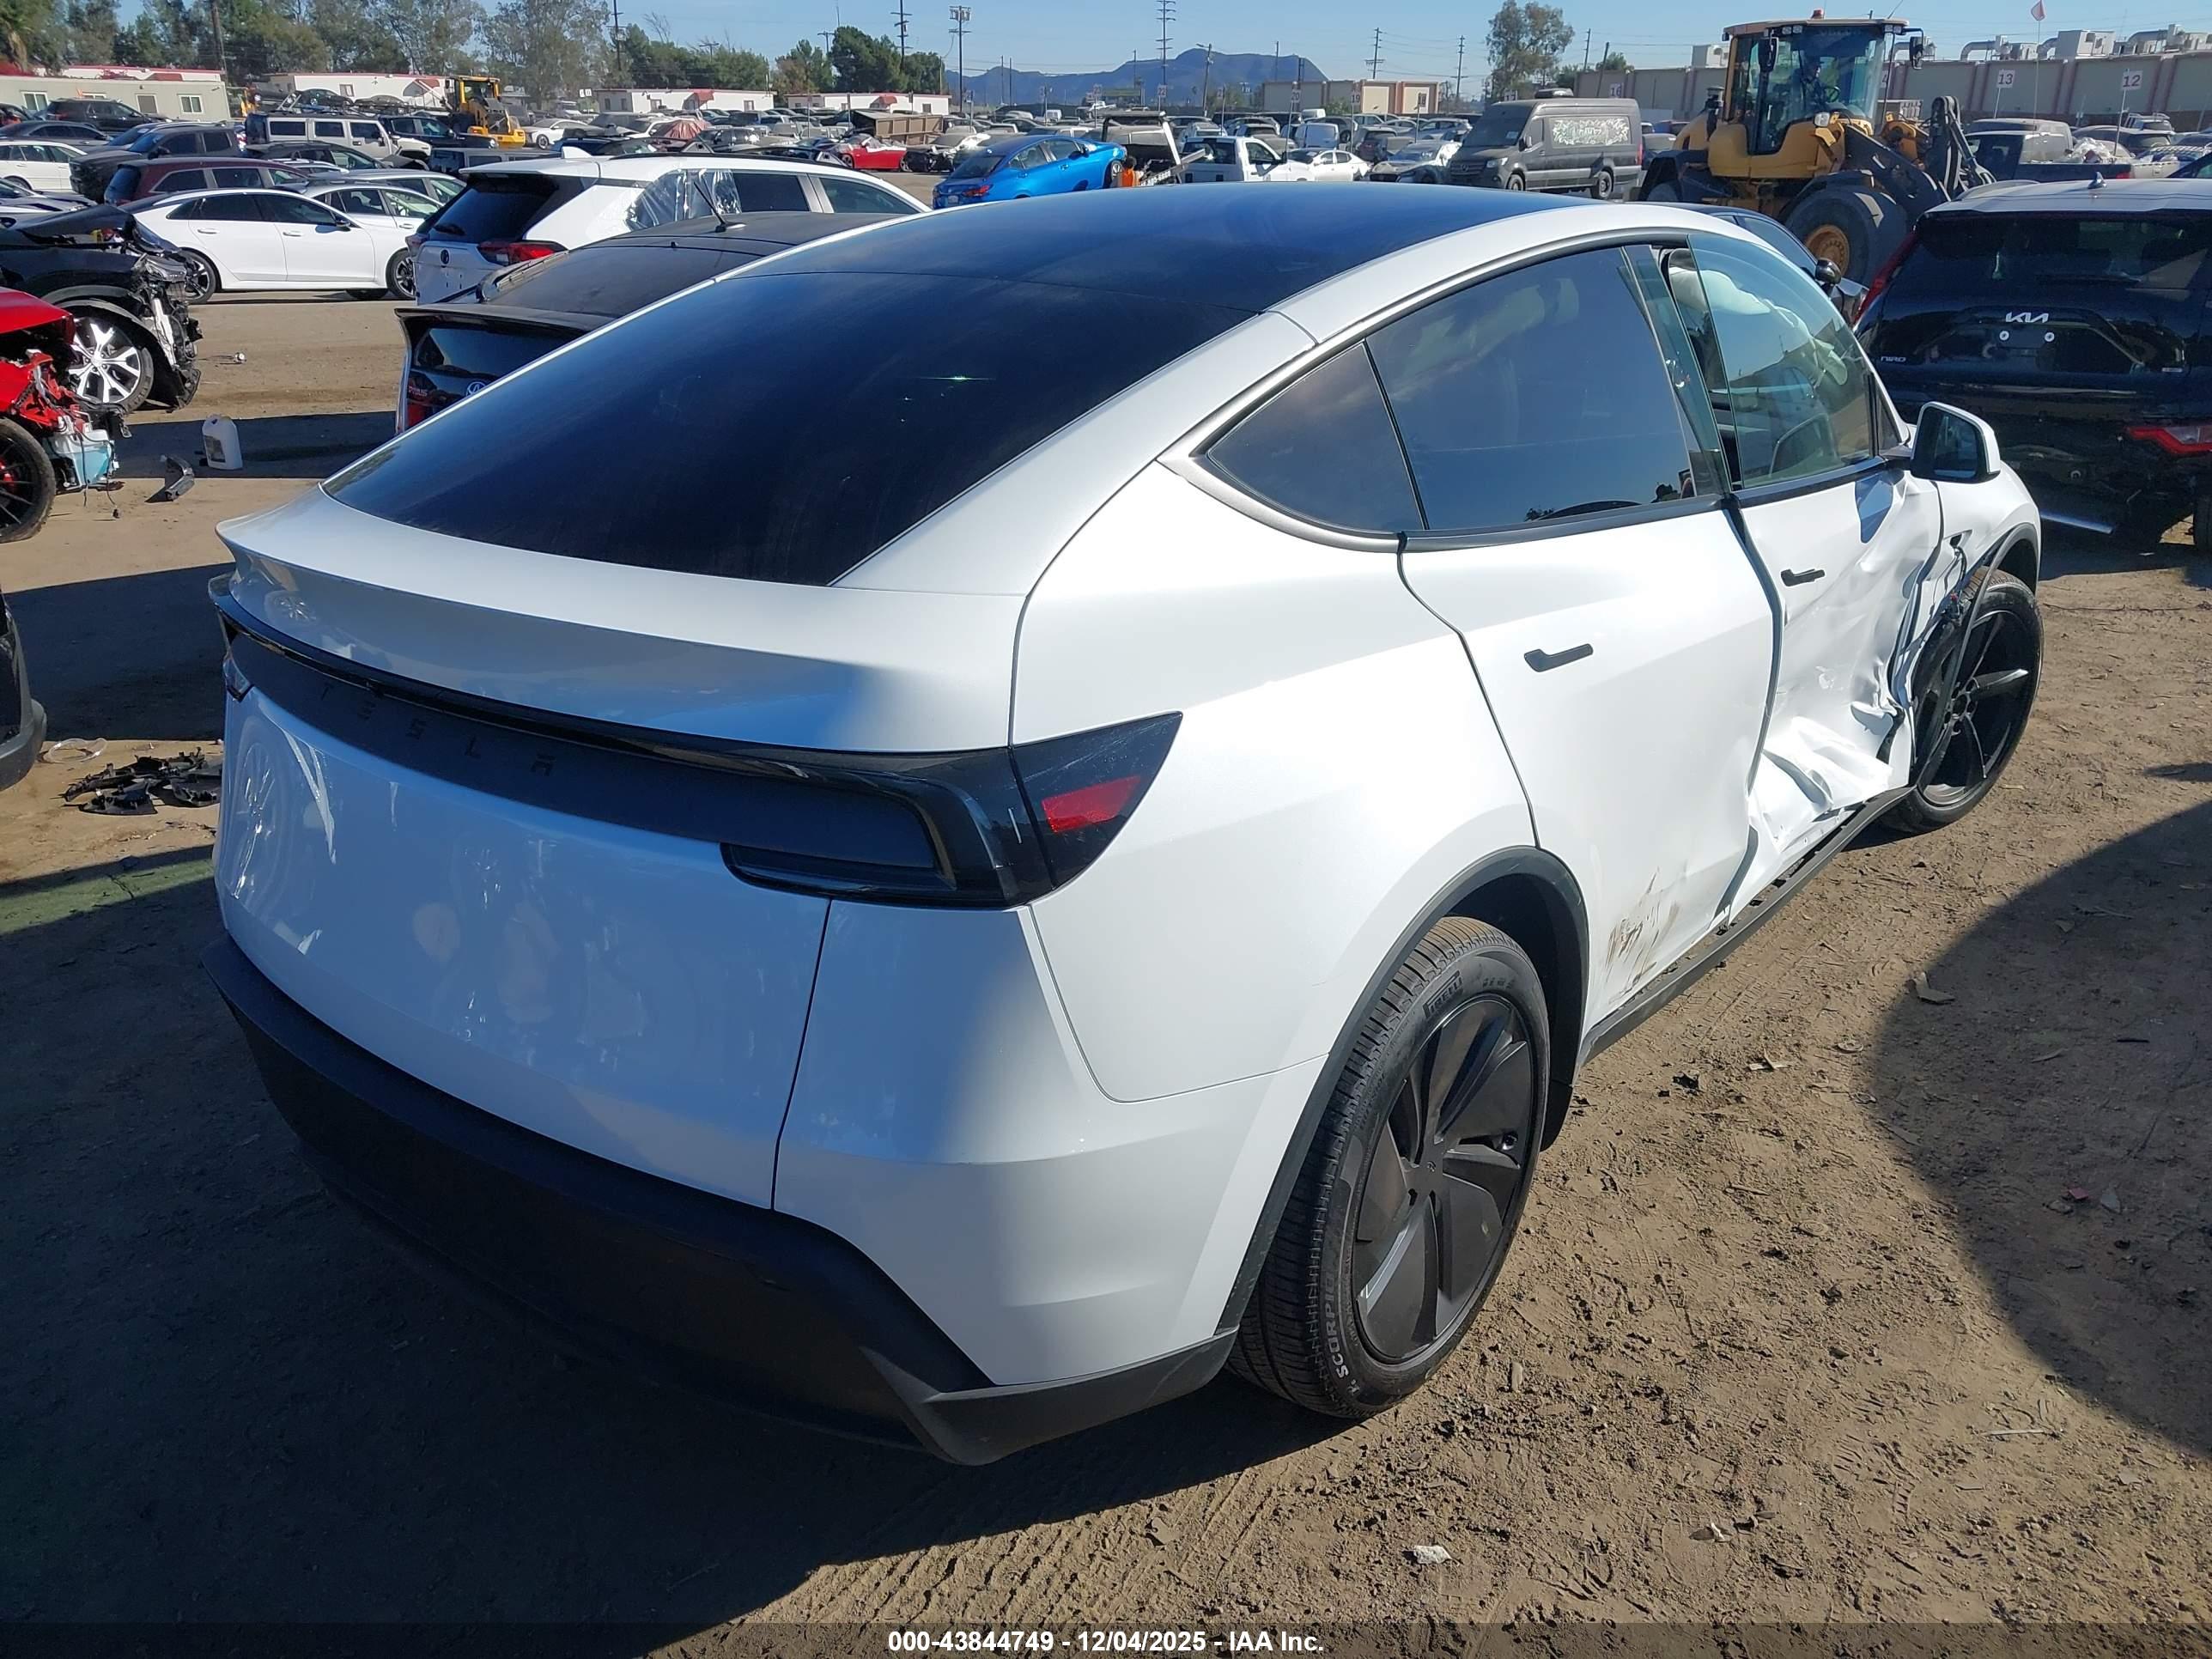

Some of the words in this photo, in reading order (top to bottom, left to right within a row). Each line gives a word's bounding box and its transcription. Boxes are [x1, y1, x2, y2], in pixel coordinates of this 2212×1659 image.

[1998, 73, 2014, 85] 13
[2123, 75, 2141, 88] 12
[1291, 91, 1300, 100] 20
[1611, 87, 1622, 97] 16
[1352, 94, 1360, 103] 19
[2005, 312, 2049, 323] KIA
[408, 386, 428, 397] PRIUS
